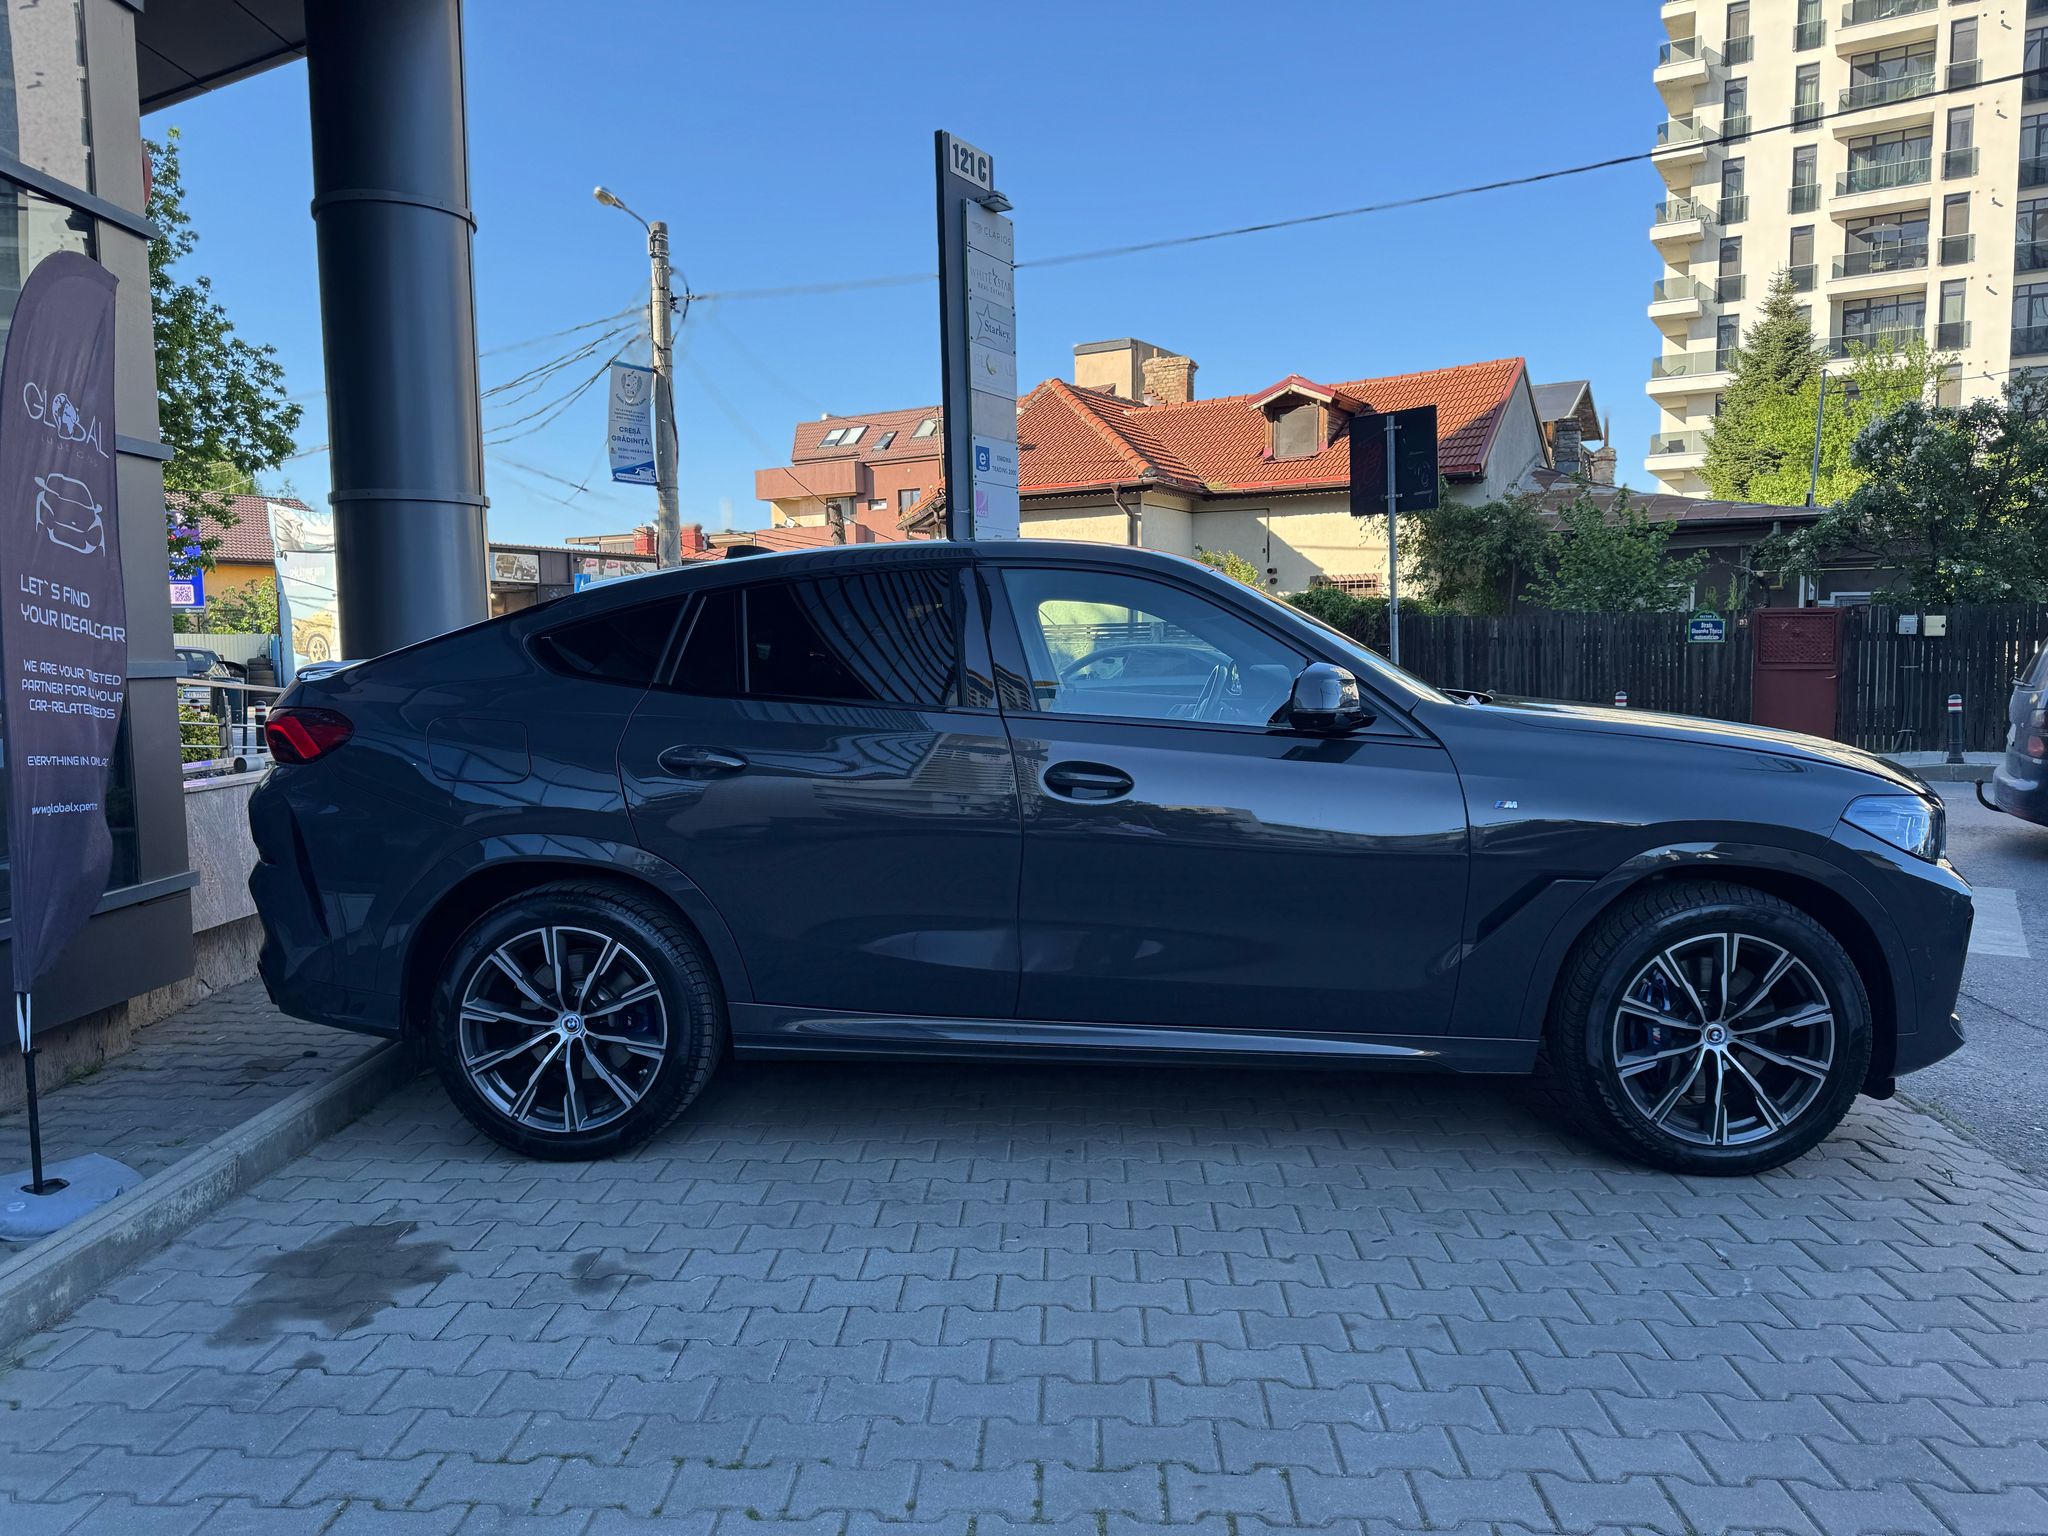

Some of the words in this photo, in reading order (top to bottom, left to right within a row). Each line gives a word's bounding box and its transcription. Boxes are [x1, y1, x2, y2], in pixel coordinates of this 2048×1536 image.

[953, 143, 975, 177] 121
[978, 156, 987, 182] C
[984, 226, 1011, 247] CLARIOS
[970, 267, 992, 285] WHITE
[984, 319, 1011, 343] Starkey
[23, 382, 109, 459] GLOBAL
[63, 586, 91, 608] FIND
[20, 602, 58, 627] YOUR
[23, 659, 38, 672] WE
[40, 661, 58, 675] ARE
[59, 664, 85, 680] YOUR
[21, 678, 63, 695] PARTNER
[65, 685, 88, 697] FOR
[80, 755, 89, 766] IN
